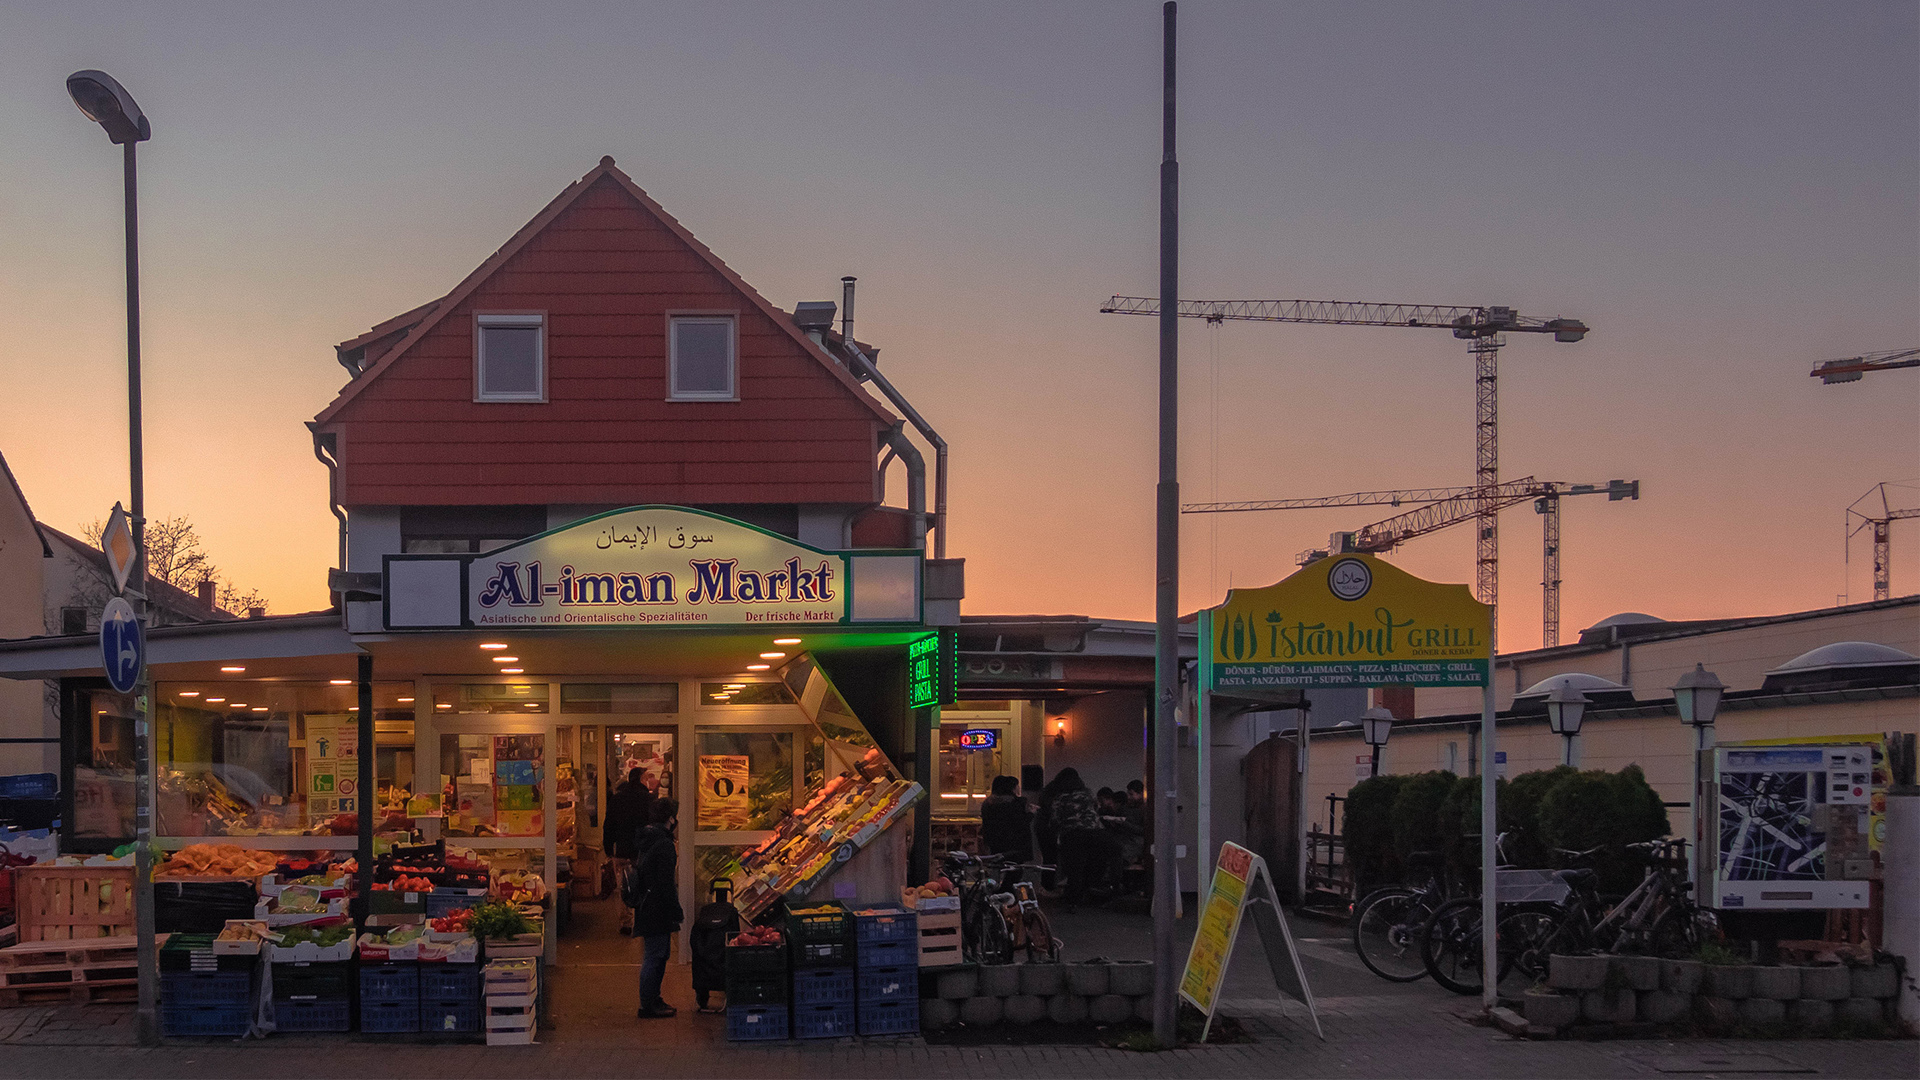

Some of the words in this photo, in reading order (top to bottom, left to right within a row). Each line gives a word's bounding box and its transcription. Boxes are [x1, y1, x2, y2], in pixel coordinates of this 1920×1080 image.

[596, 525, 657, 550] الإيمان
[668, 526, 713, 549] سوق
[479, 560, 678, 608] Al-iman
[686, 556, 835, 605] Markt
[480, 615, 537, 623] Asiatische
[540, 614, 561, 623] und
[564, 613, 636, 623] Orientalische
[639, 612, 708, 622] Spezialitäten
[746, 611, 764, 622] Der
[766, 611, 801, 621] frische
[804, 610, 834, 621] Markt
[1225, 666, 1256, 675] DÖNER
[1262, 665, 1295, 675] DÜRÜM
[1301, 665, 1352, 674] LAHMACUN
[1359, 665, 1384, 673] PIZZA
[1391, 662, 1441, 673] HÄHNCHEN
[1219, 677, 1245, 685] PASTA
[1252, 676, 1313, 684] PANZAEROTTI
[1319, 675, 1353, 684] SUPPEN
[1359, 674, 1399, 683] BAKLAVA
[1405, 673, 1441, 682] KÜNEFE
[1447, 673, 1481, 681] SALATE
[914, 679, 932, 702] PASTA
[961, 734, 993, 745] OPEN
